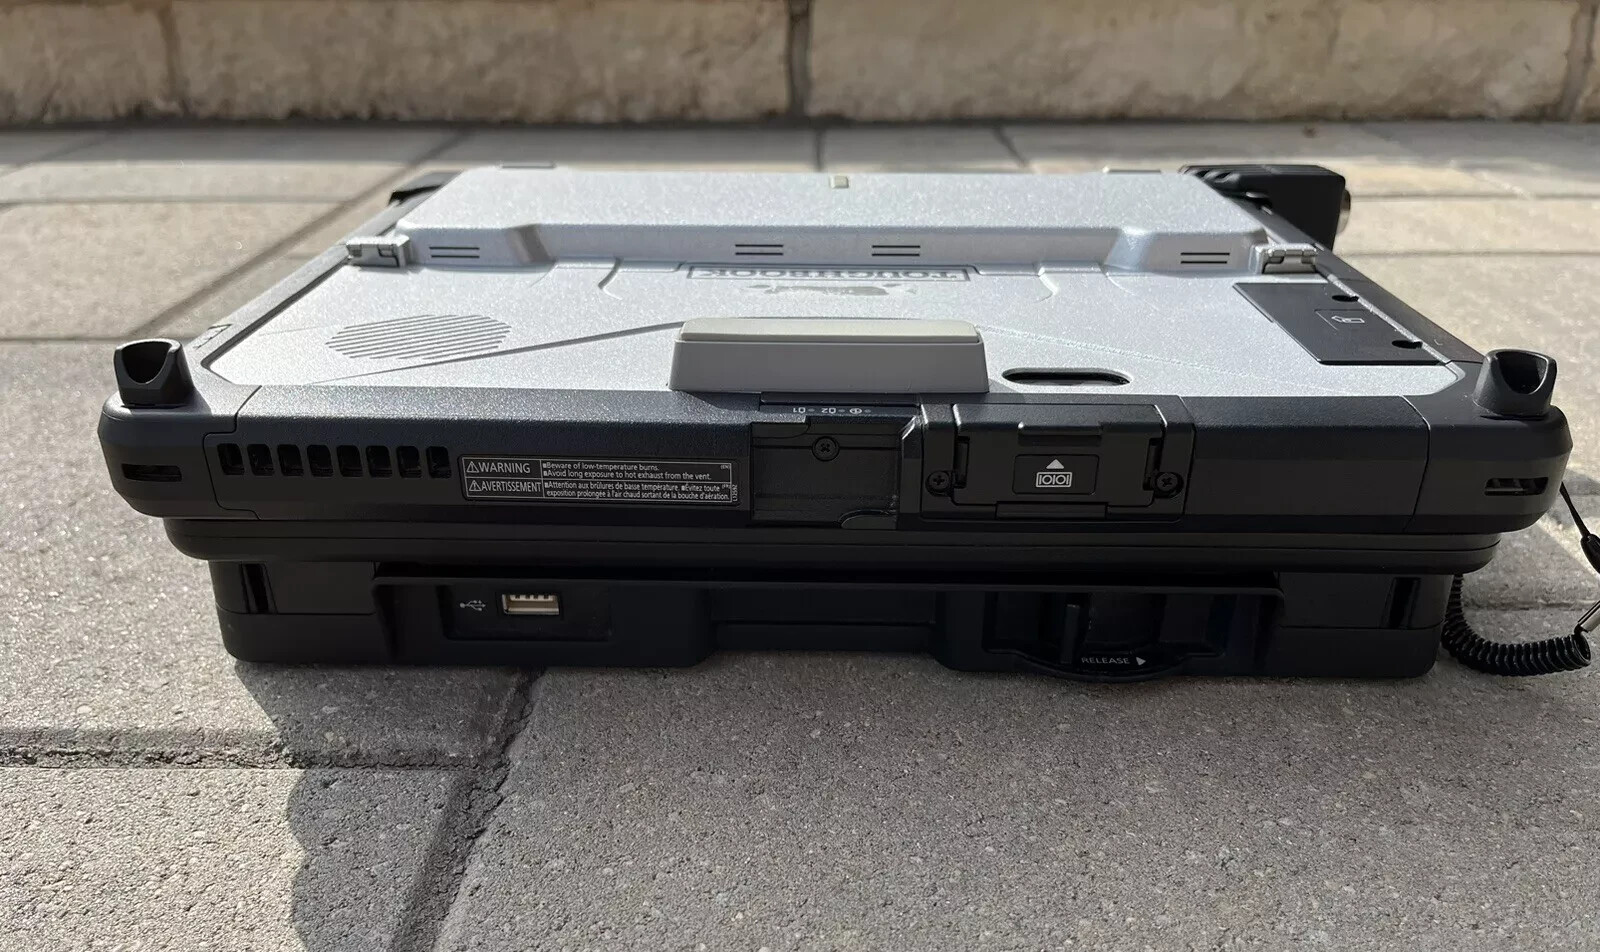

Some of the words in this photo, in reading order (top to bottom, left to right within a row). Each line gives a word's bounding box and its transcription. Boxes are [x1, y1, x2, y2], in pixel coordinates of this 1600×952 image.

[698, 268, 957, 279] TOUGHBOOK
[478, 462, 531, 474] WARNING
[546, 461, 572, 470] Beware
[573, 461, 581, 470] of
[581, 462, 638, 472] low-temperature
[639, 463, 660, 472] burns.
[547, 469, 567, 478] Avoid
[567, 469, 584, 479] long
[584, 471, 615, 480] exposure
[615, 471, 624, 479] to
[624, 470, 637, 480] hot
[637, 471, 664, 480] exhaust
[664, 471, 682, 480] from
[682, 472, 694, 480] the
[481, 480, 541, 493] AVERTISSEMENT
[548, 480, 577, 489] Attention
[577, 482, 590, 490] aux
[614, 481, 624, 490] de
[703, 484, 720, 492] toute
[546, 489, 577, 499] exposition
[662, 491, 671, 500] de
[677, 491, 699, 500] bouche
